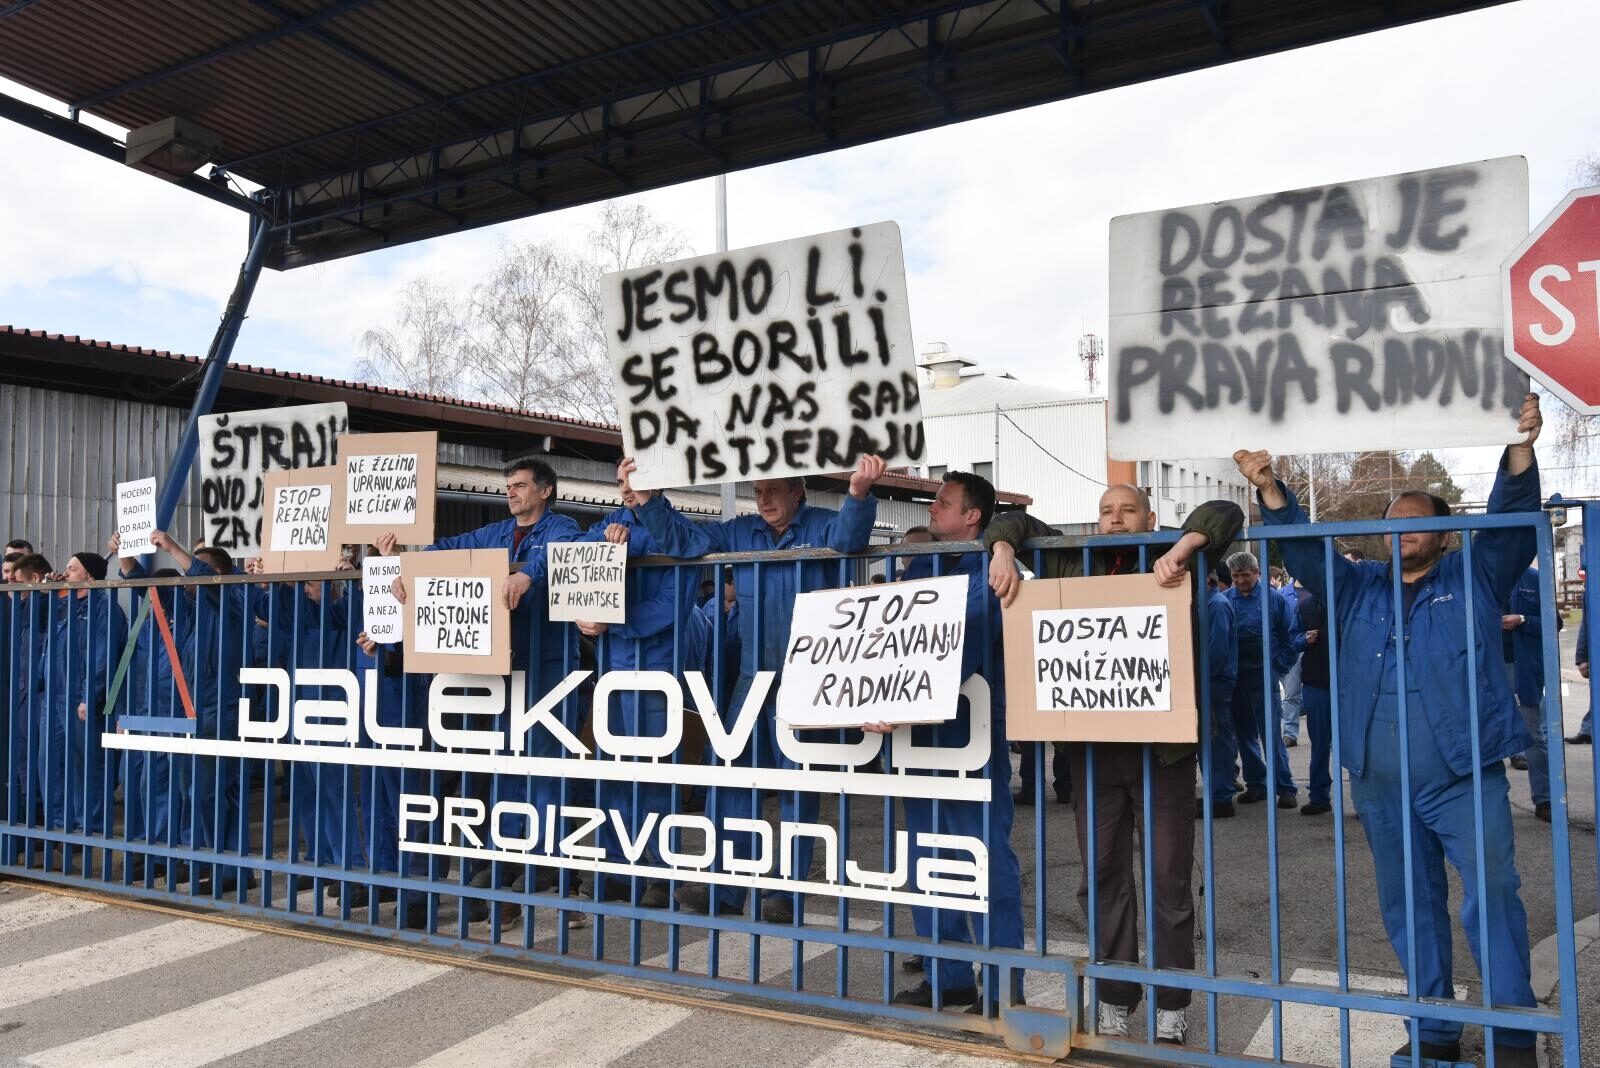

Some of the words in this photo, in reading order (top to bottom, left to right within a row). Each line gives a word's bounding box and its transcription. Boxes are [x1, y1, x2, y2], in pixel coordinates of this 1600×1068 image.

[1159, 185, 1366, 276] DOSTA
[1384, 169, 1479, 251] JE
[617, 258, 773, 342] JESMO
[621, 346, 679, 405] SE
[692, 289, 891, 385] BORILI
[1115, 332, 1318, 424] PRAVA
[630, 405, 701, 450] DA
[725, 381, 819, 432] NAS
[848, 371, 919, 420] SAD
[348, 459, 365, 474] NE
[248, 475, 264, 510] J
[279, 487, 321, 505] STOP
[123, 504, 146, 515] RADITI
[348, 499, 363, 514] NE
[119, 524, 131, 533] OD
[132, 520, 152, 531] RADA
[211, 516, 250, 549] ZA
[369, 566, 380, 576] MI
[382, 565, 400, 576] SMO
[551, 566, 579, 587] NAS
[369, 585, 380, 595] ZA
[381, 585, 392, 595] RA
[550, 592, 560, 607] IZ
[567, 590, 620, 608] HRVATSKE
[368, 606, 375, 616] A
[376, 605, 387, 615] NE
[388, 605, 398, 615] ZA
[828, 590, 939, 631] STOP
[371, 624, 394, 635] GLAD!
[1038, 615, 1128, 644] DOSTA
[1136, 613, 1164, 640] JE
[812, 664, 933, 708] RADNIKA
[1051, 681, 1156, 710] RADNIKA
